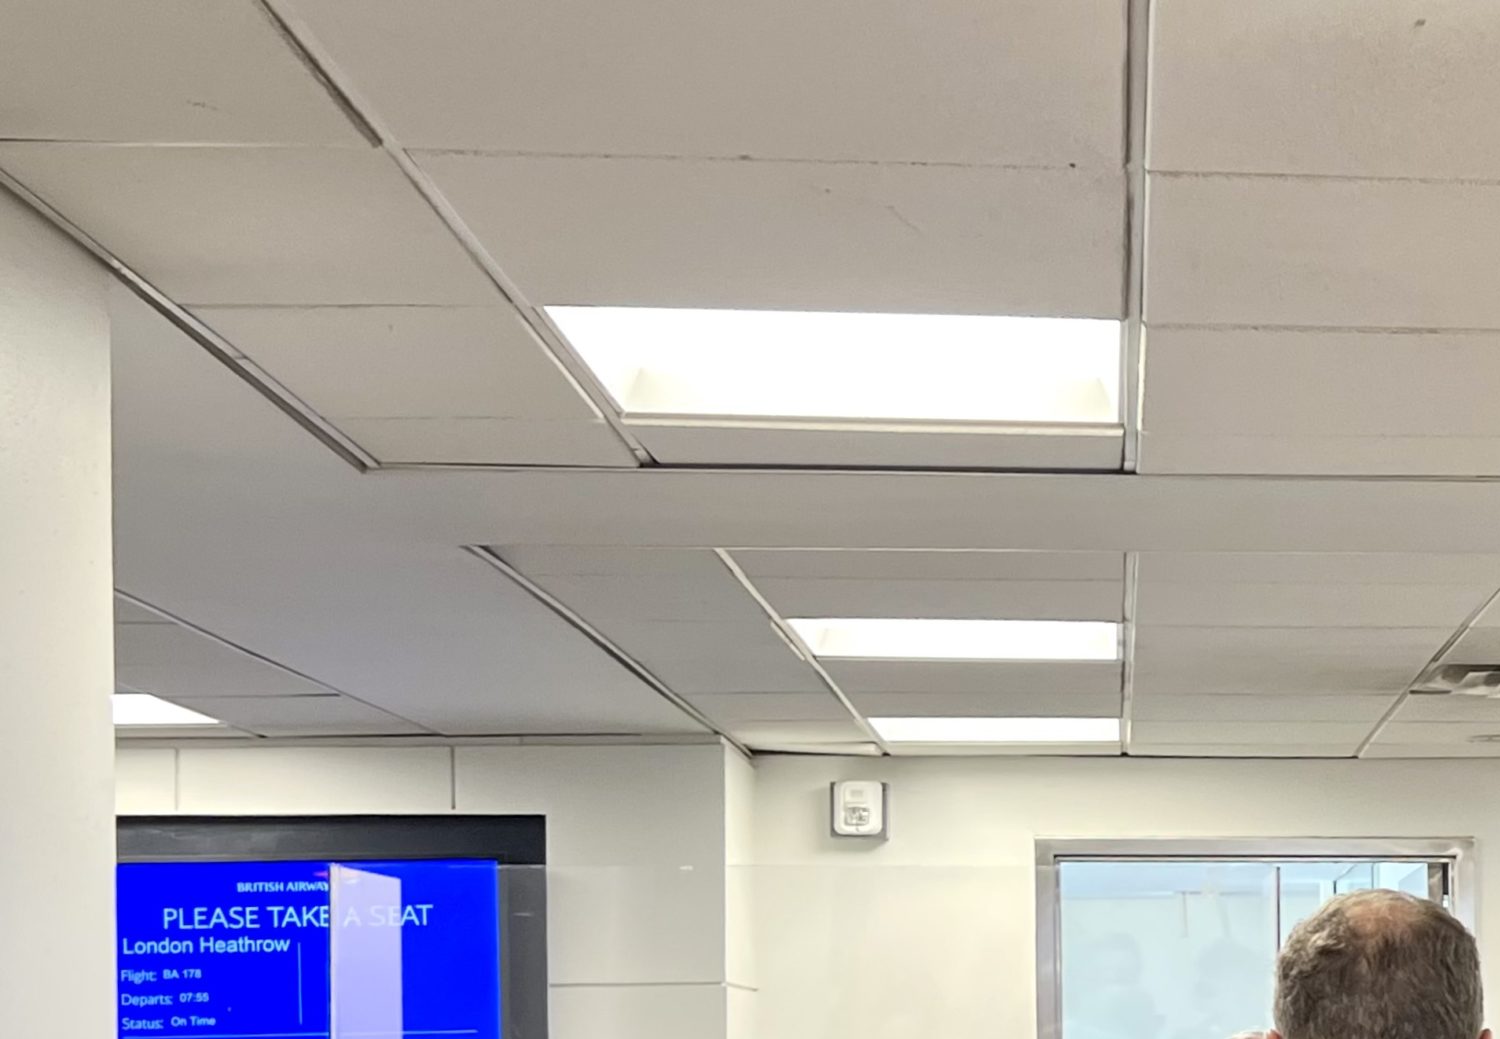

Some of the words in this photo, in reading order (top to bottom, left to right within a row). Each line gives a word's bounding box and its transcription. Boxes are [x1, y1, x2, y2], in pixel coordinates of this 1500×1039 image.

[236, 882, 284, 893] BRITISH
[286, 881, 329, 892] AIRWAY
[163, 906, 260, 930] PLEASE
[265, 905, 330, 928] TAKE
[343, 907, 361, 927] A
[368, 903, 434, 927] SEAT
[122, 937, 194, 955] London
[199, 935, 291, 954] Heathrow
[120, 969, 158, 984] Flight:
[162, 968, 180, 980] BA
[120, 993, 174, 1007] Departs:
[121, 1017, 164, 1030] Status:
[170, 1016, 187, 1027] On
[189, 1015, 217, 1026] Time
